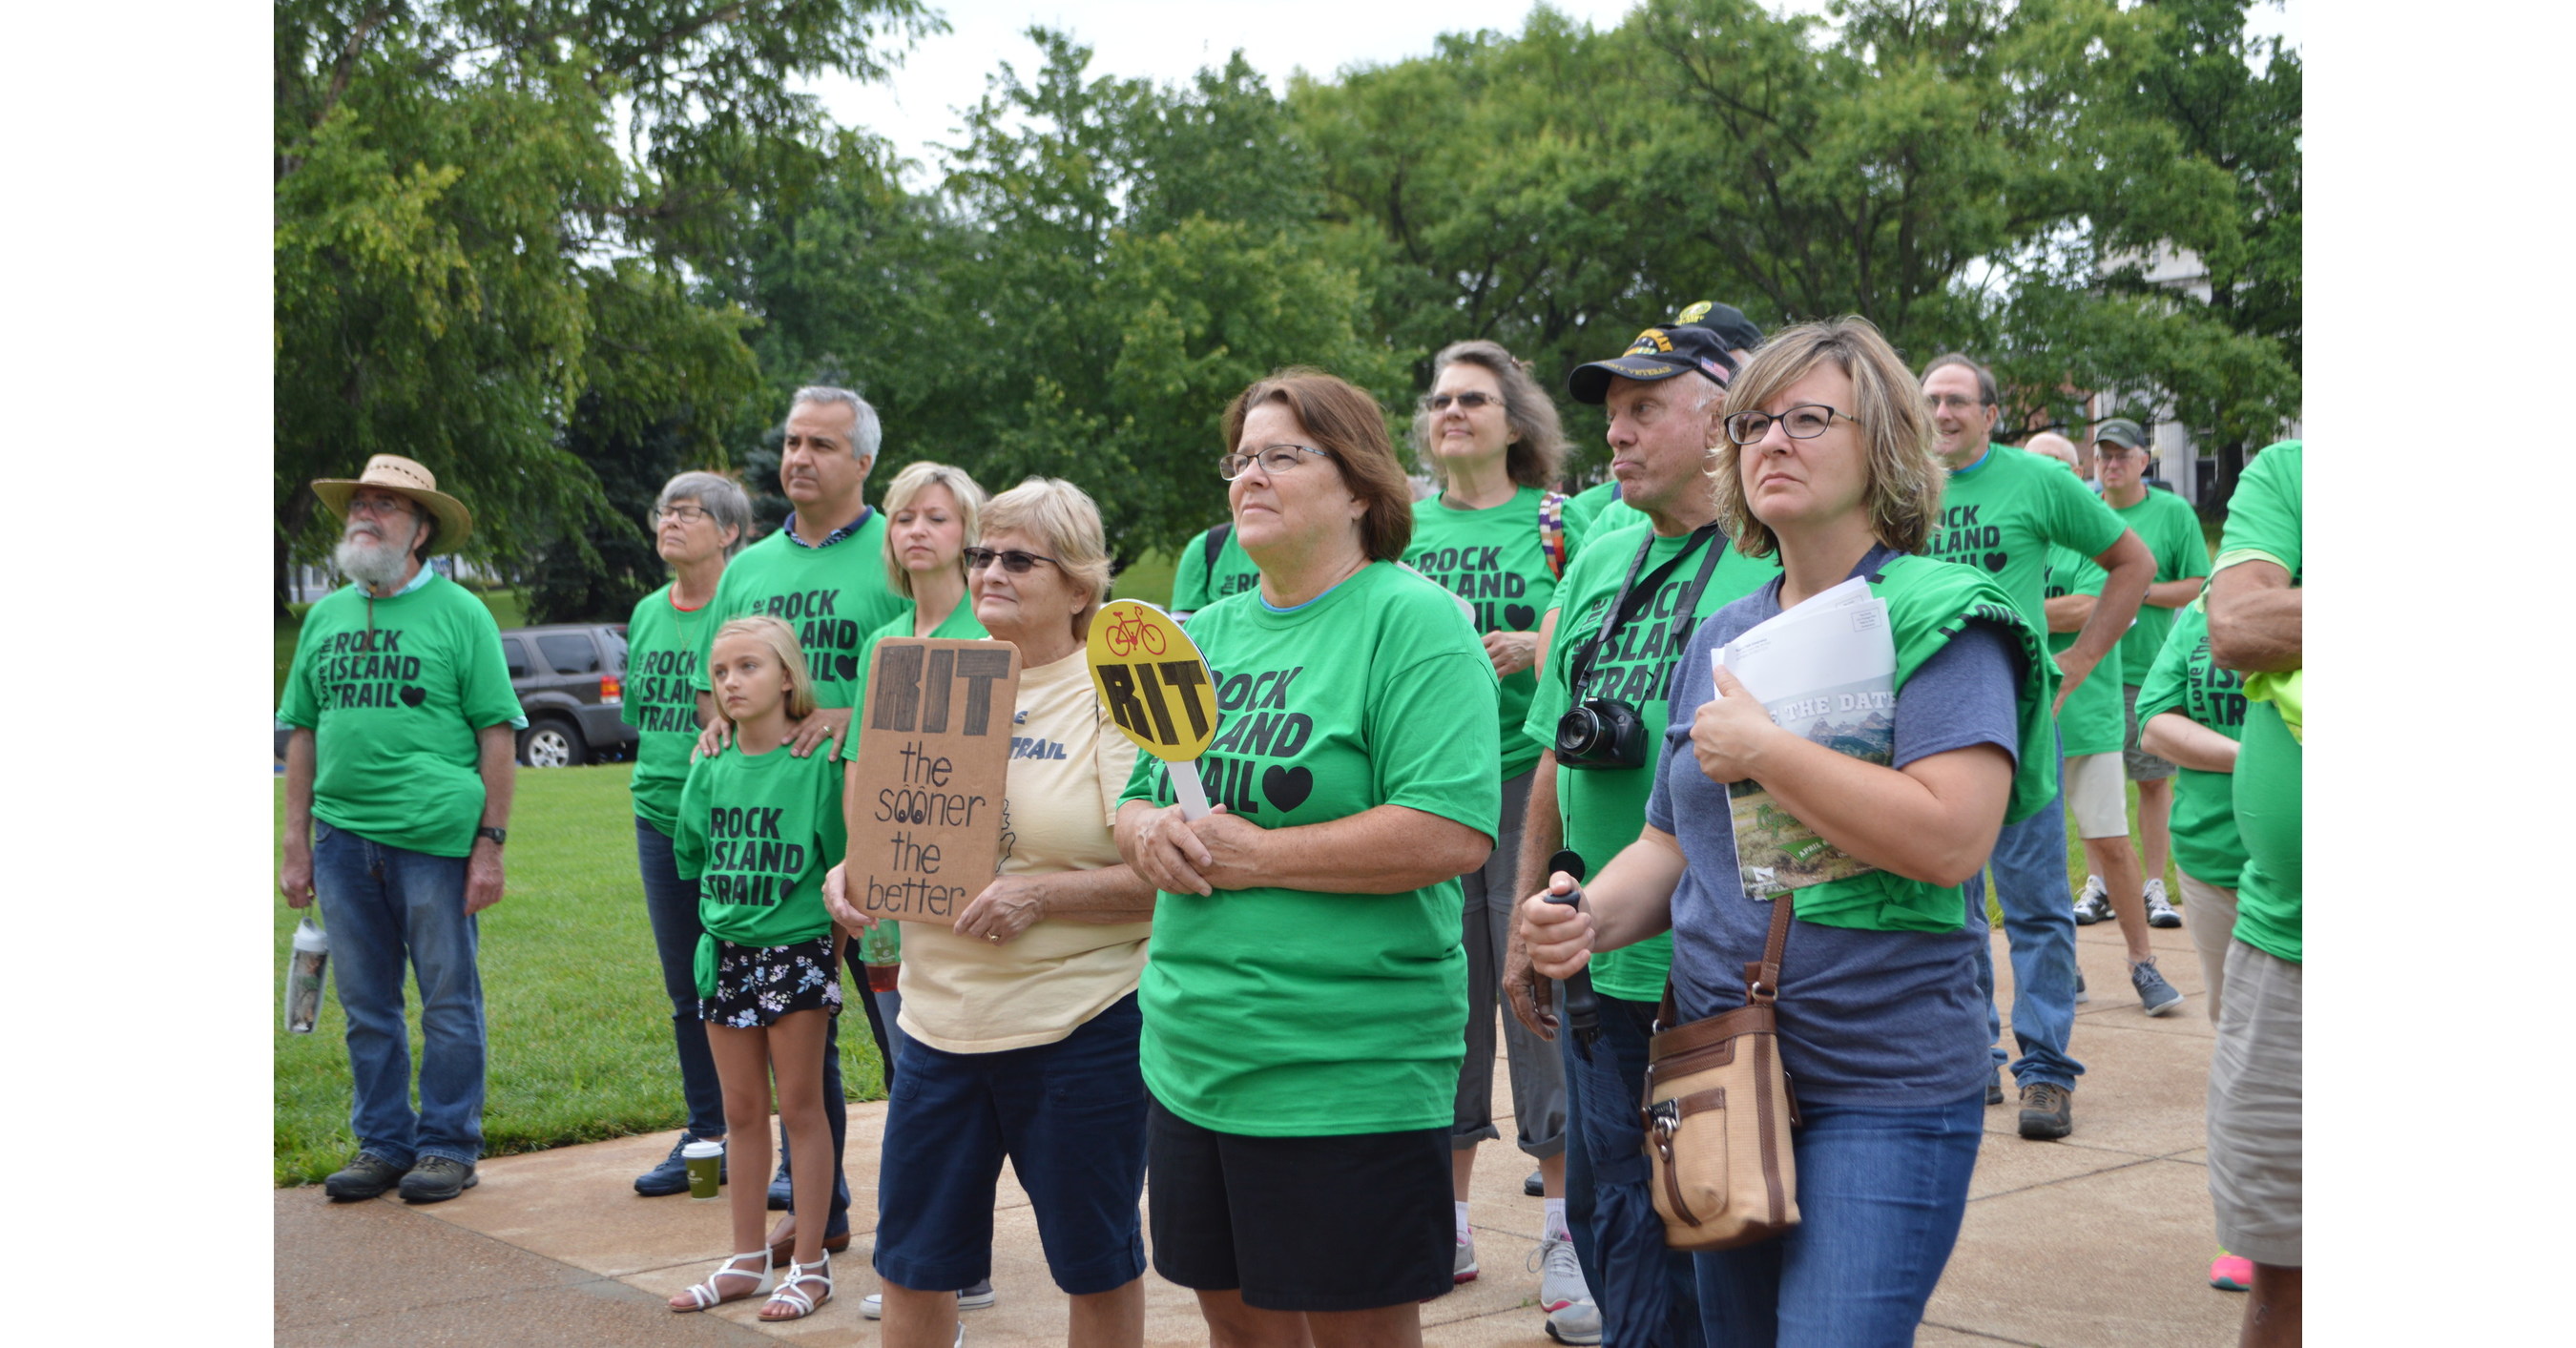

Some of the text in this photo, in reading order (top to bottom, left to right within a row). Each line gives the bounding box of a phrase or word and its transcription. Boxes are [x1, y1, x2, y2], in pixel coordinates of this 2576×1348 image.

[1418, 546, 1503, 572] ROCK
[1425, 572, 1526, 599] AND
[767, 589, 840, 620] ROCK
[1628, 580, 1695, 625] OCK
[334, 629, 403, 654] ROCK
[791, 618, 858, 651] AND
[1599, 616, 1708, 665] SLAN
[329, 654, 421, 682] ISLAND
[643, 651, 697, 675] ROCK
[331, 682, 398, 709] TRAIL
[870, 645, 1011, 736] RIT
[1096, 660, 1209, 745] RIT
[2190, 667, 2207, 712] Love
[638, 706, 694, 733] TRAIL
[1784, 696, 1831, 722] THE
[900, 740, 952, 787] the
[710, 807, 783, 840] ROCK
[711, 840, 805, 875] SLAND
[891, 831, 941, 874] the
[1798, 842, 1823, 859] APRIL
[704, 874, 776, 907] TRAIL
[866, 875, 966, 917] better
